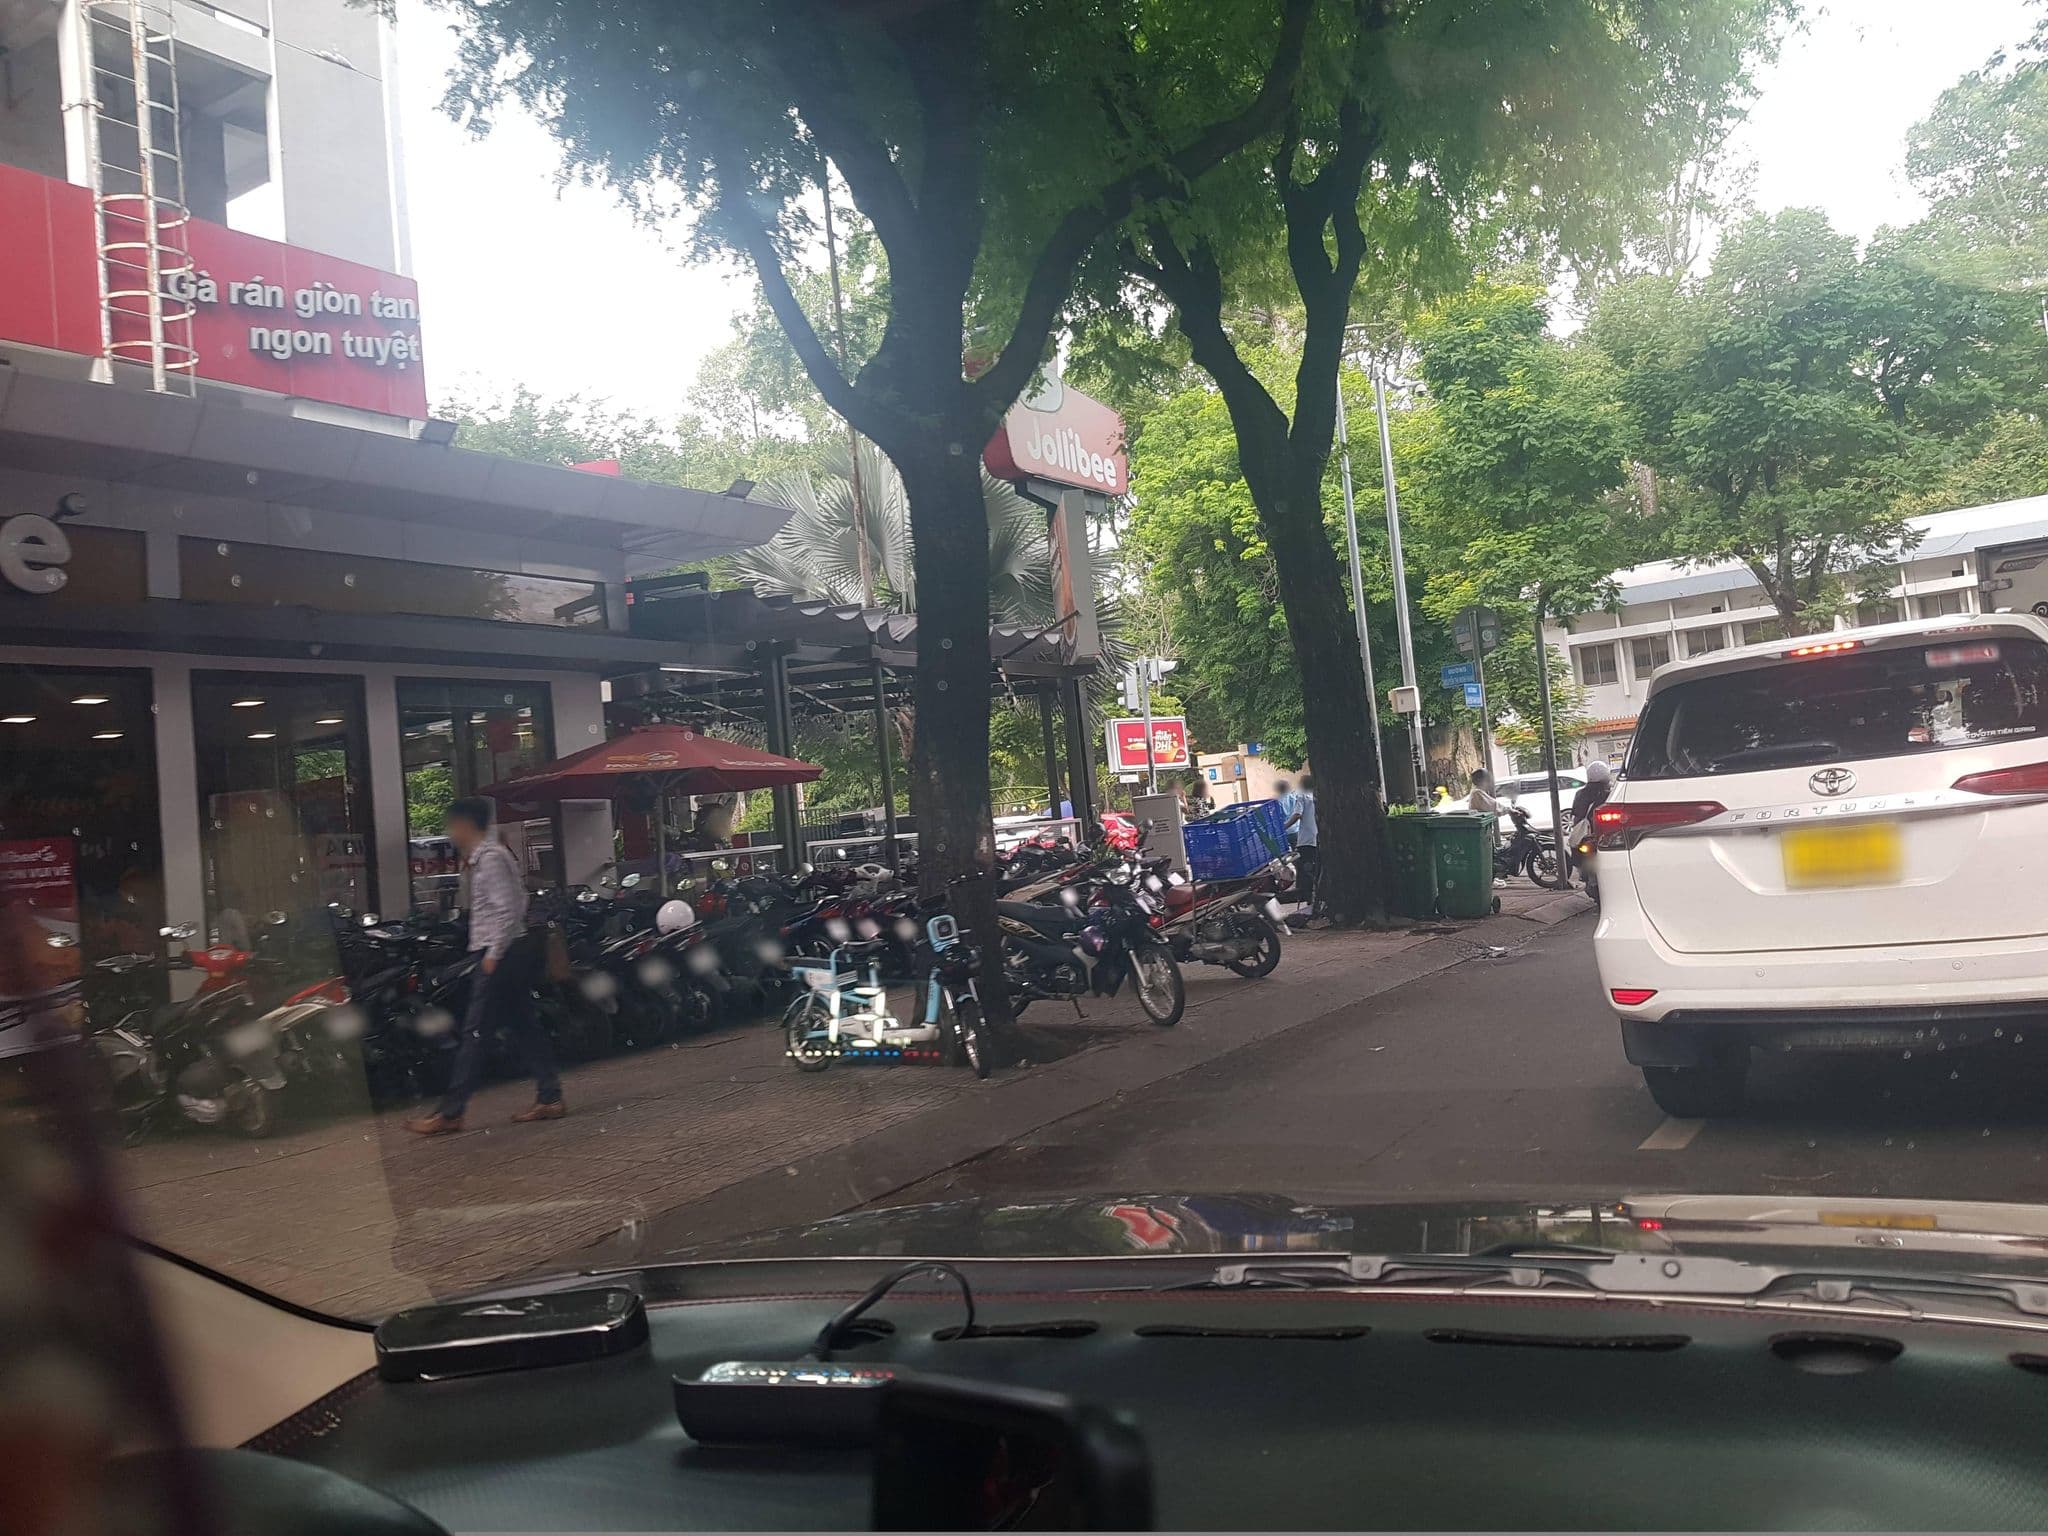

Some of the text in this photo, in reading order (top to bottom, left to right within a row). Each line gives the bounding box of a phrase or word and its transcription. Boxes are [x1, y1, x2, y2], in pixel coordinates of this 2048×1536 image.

[166, 269, 219, 304] Gà
[229, 275, 285, 309] rán
[295, 281, 362, 319] giòn
[250, 326, 421, 370] ngon tuyệt
[1026, 416, 1117, 488] Jollibee
